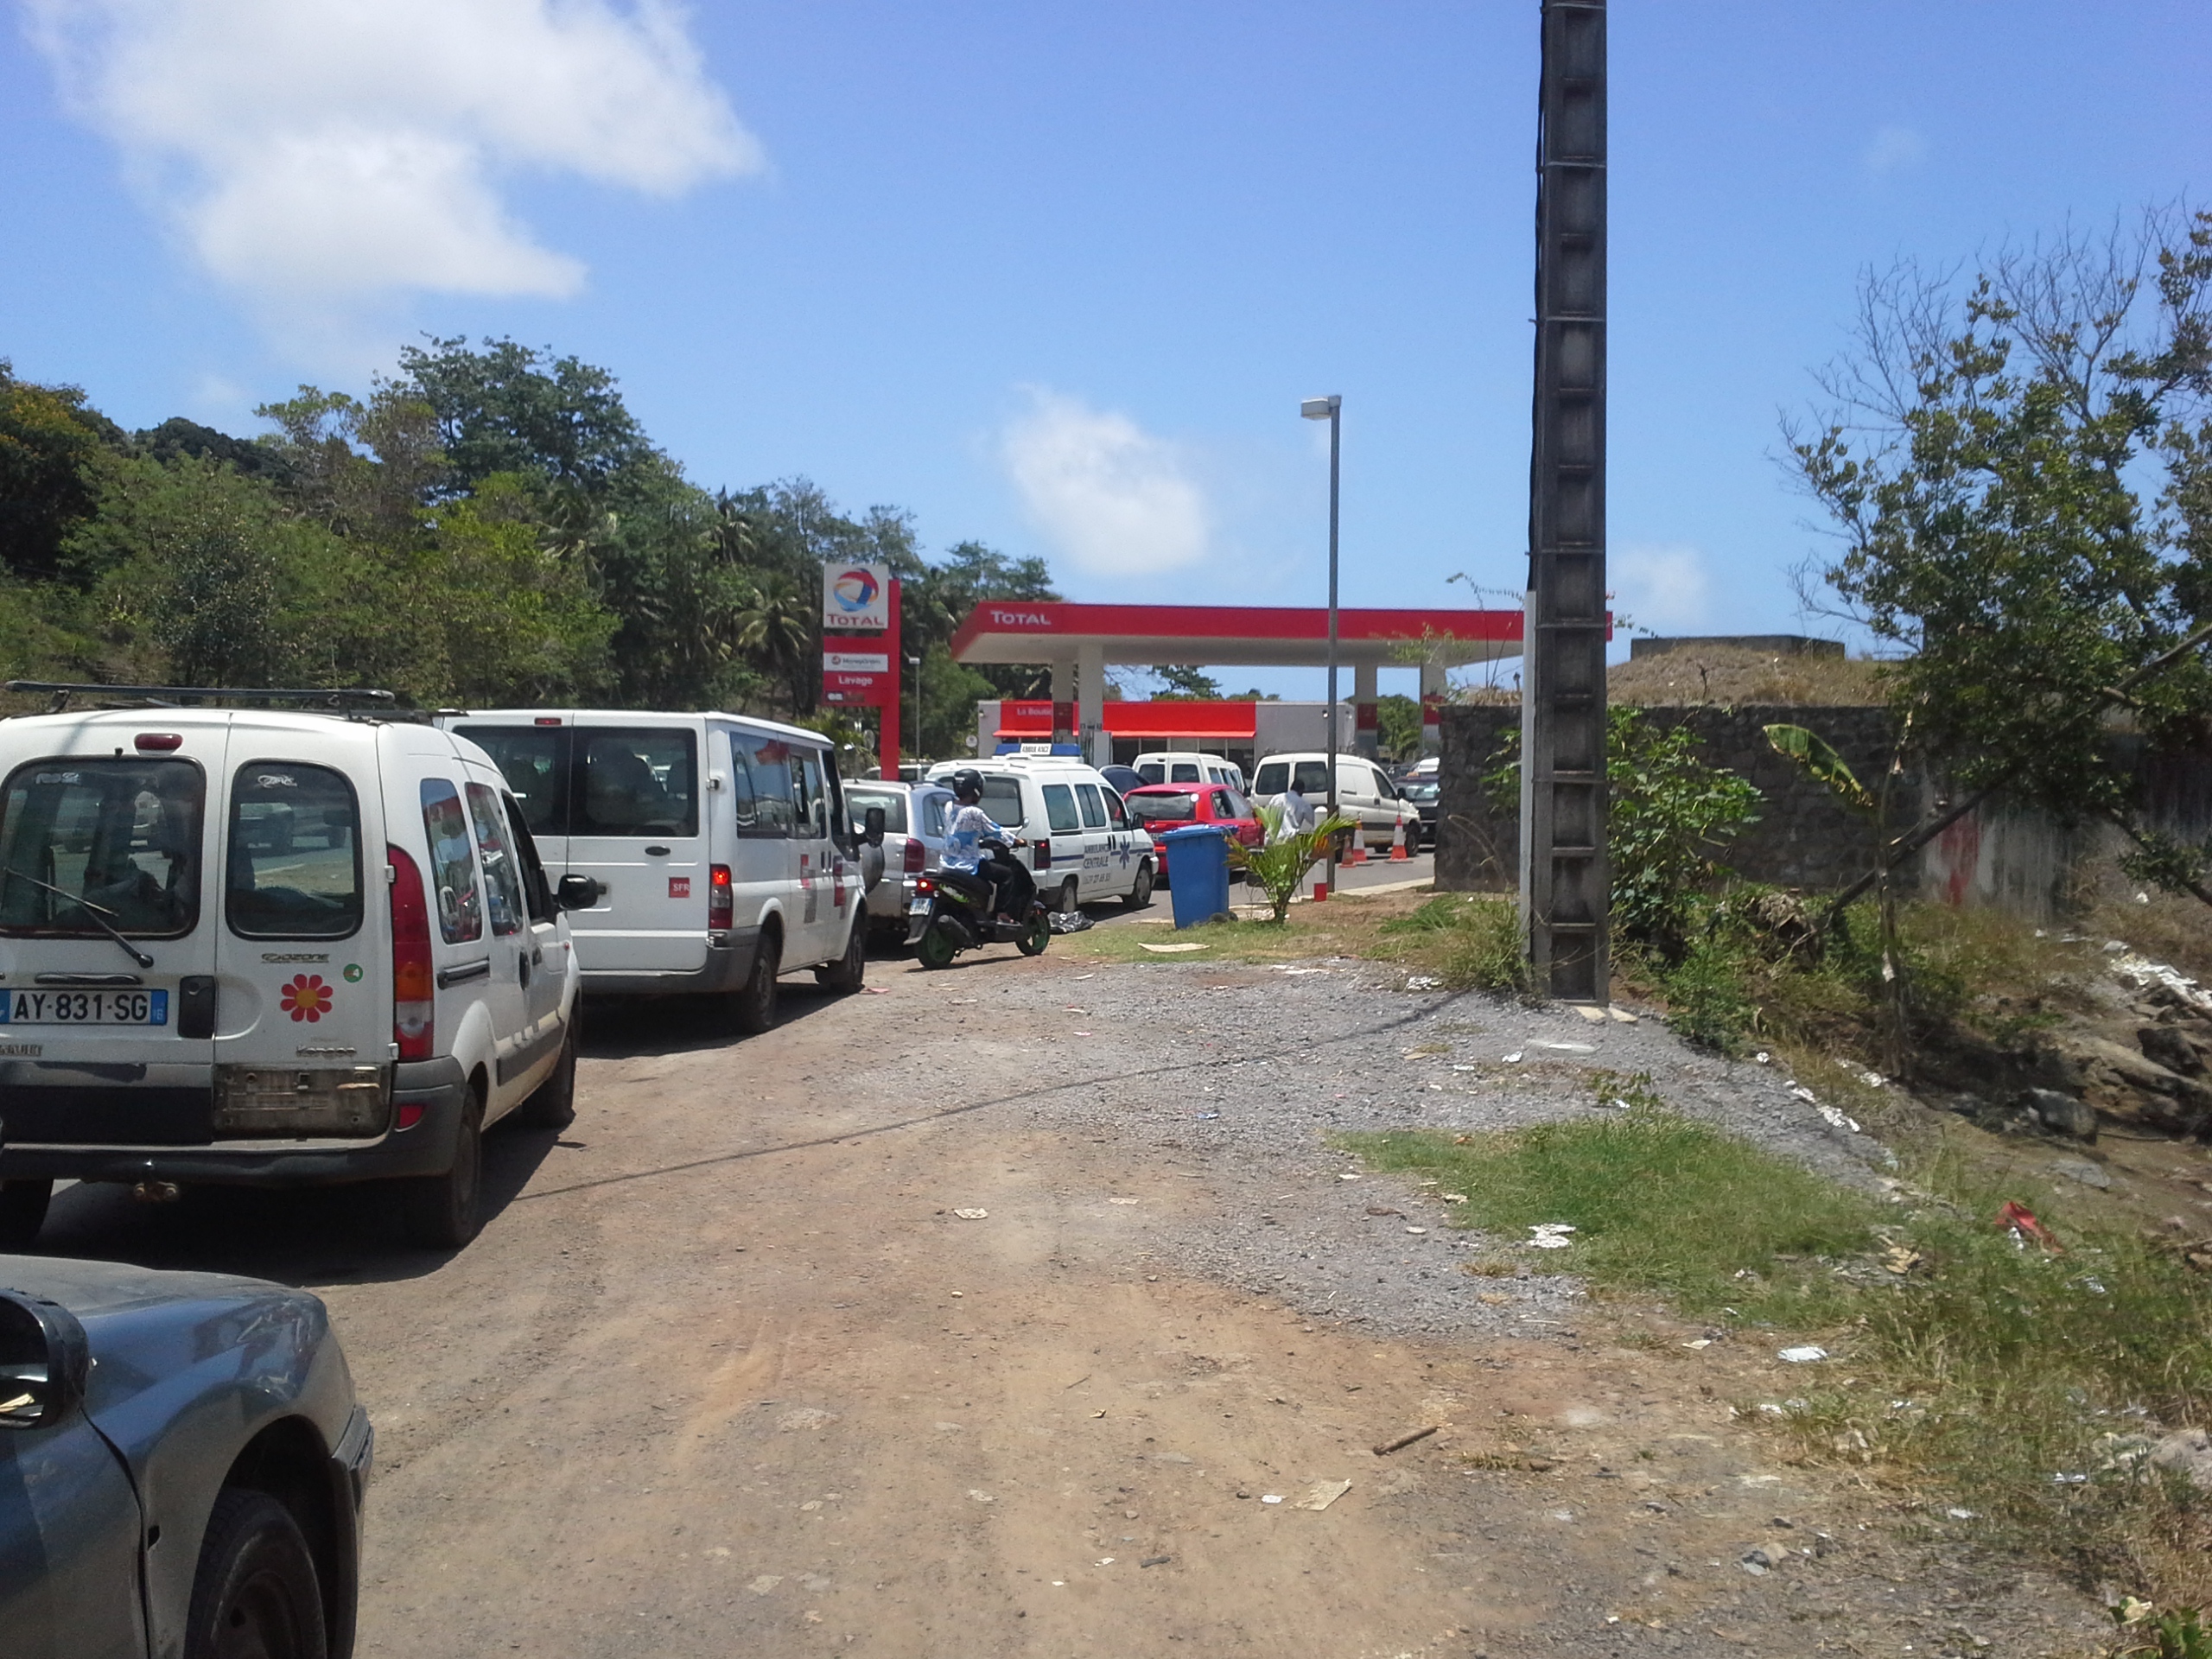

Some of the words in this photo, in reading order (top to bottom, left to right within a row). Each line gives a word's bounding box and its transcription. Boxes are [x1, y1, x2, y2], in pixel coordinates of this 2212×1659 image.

[827, 613, 884, 626] TOTAL
[990, 610, 1052, 625] TOTAL
[838, 676, 873, 686] Lavage
[1084, 856, 1109, 868] CENTRALE
[673, 883, 690, 892] SFR
